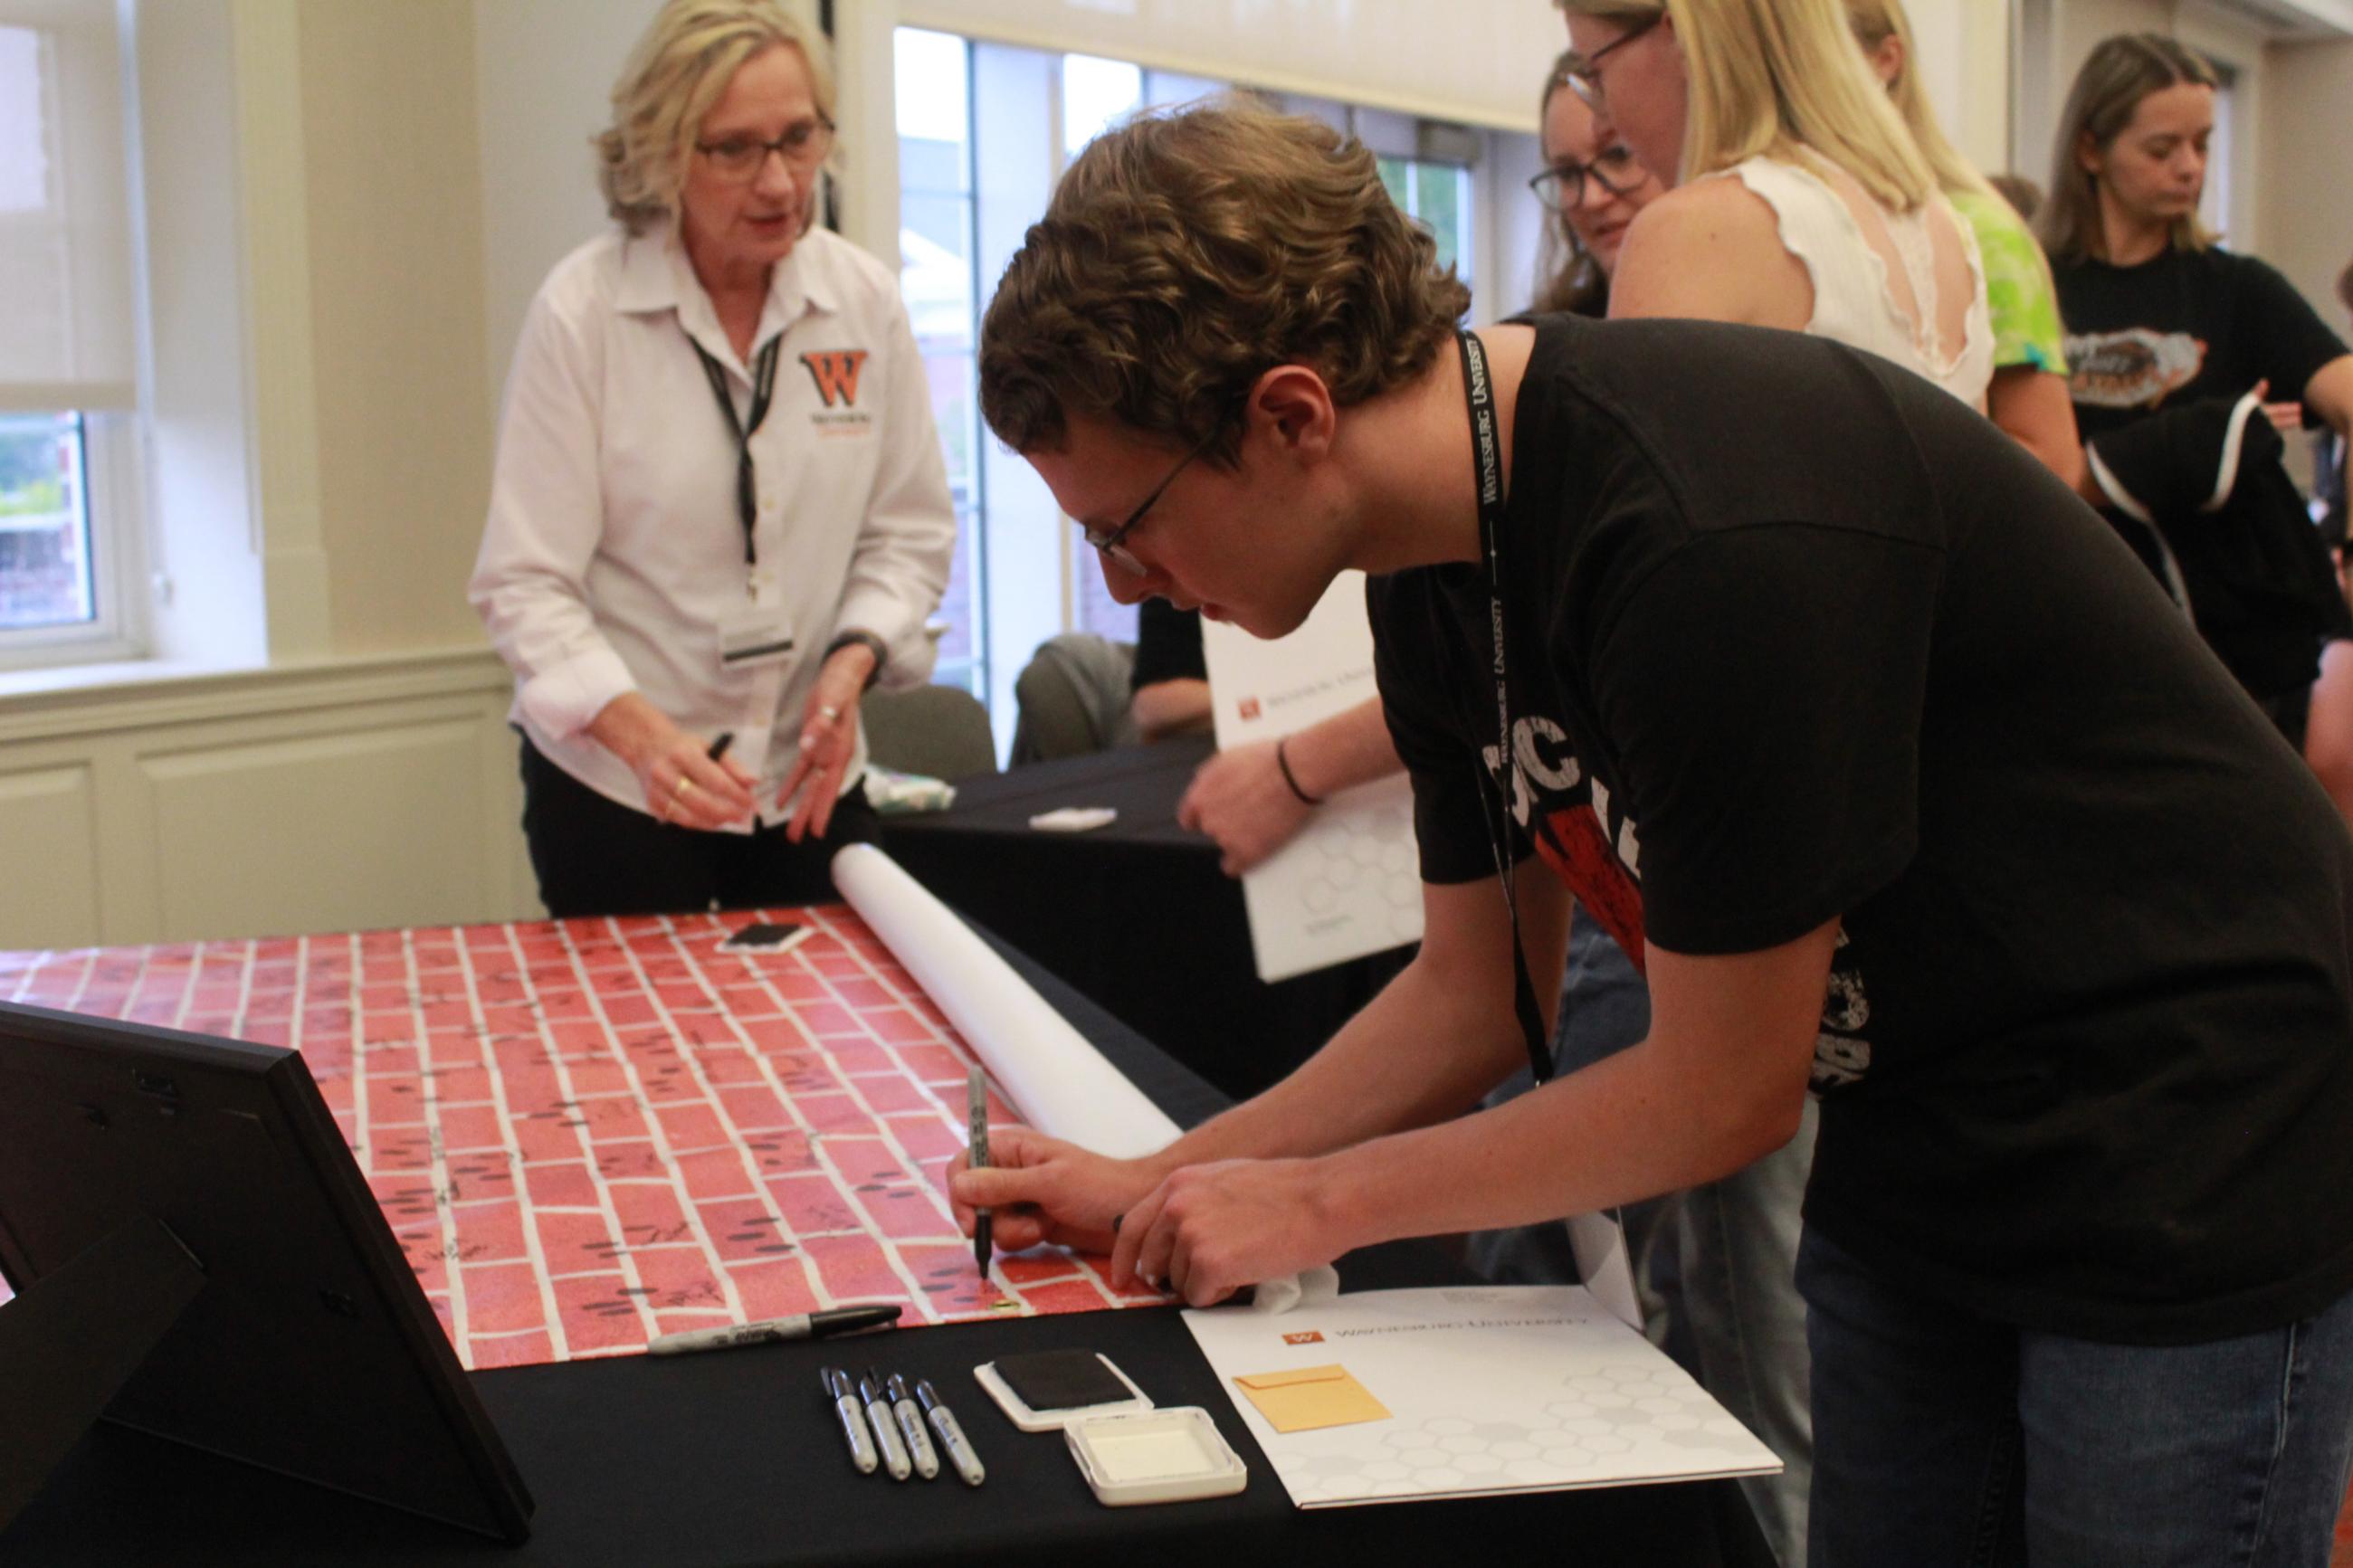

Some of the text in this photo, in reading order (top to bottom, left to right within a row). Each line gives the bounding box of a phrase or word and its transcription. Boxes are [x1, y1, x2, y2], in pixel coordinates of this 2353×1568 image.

[798, 349, 870, 407] W
[1466, 337, 1497, 505] WAYNESBURG UNIVERSITY
[1491, 596, 1505, 675] UNIVERSITY
